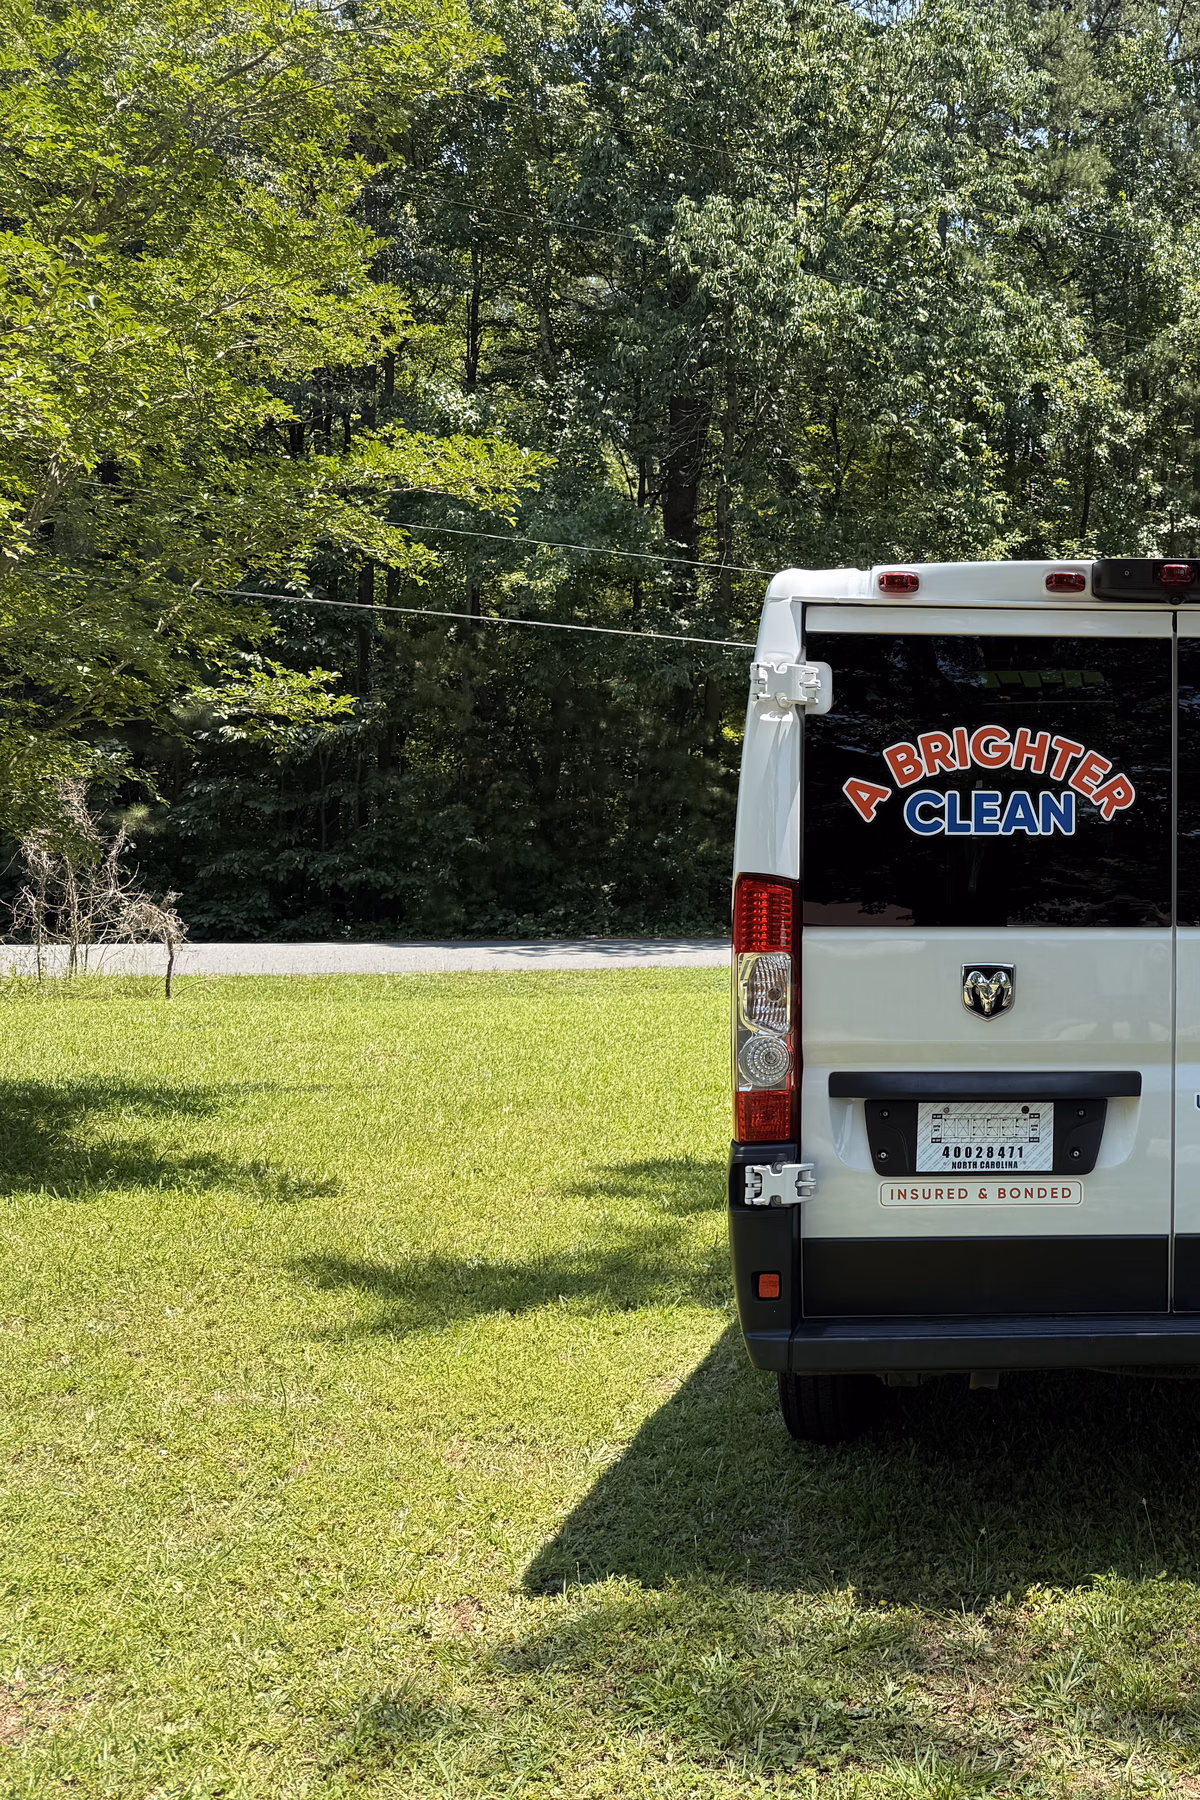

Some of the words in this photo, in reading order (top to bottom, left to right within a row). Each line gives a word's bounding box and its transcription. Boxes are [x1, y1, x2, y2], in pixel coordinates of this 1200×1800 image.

[842, 777, 892, 823] A
[882, 724, 1136, 821] BRIGHTER
[903, 789, 1076, 836] CLEAN
[942, 1146, 1024, 1159] 40028471
[951, 1161, 978, 1170] NORTH
[980, 1160, 1018, 1170] CAROLINA
[890, 1188, 969, 1200] INSURED
[978, 1188, 988, 1199] &
[998, 1187, 1072, 1199] BONDED
